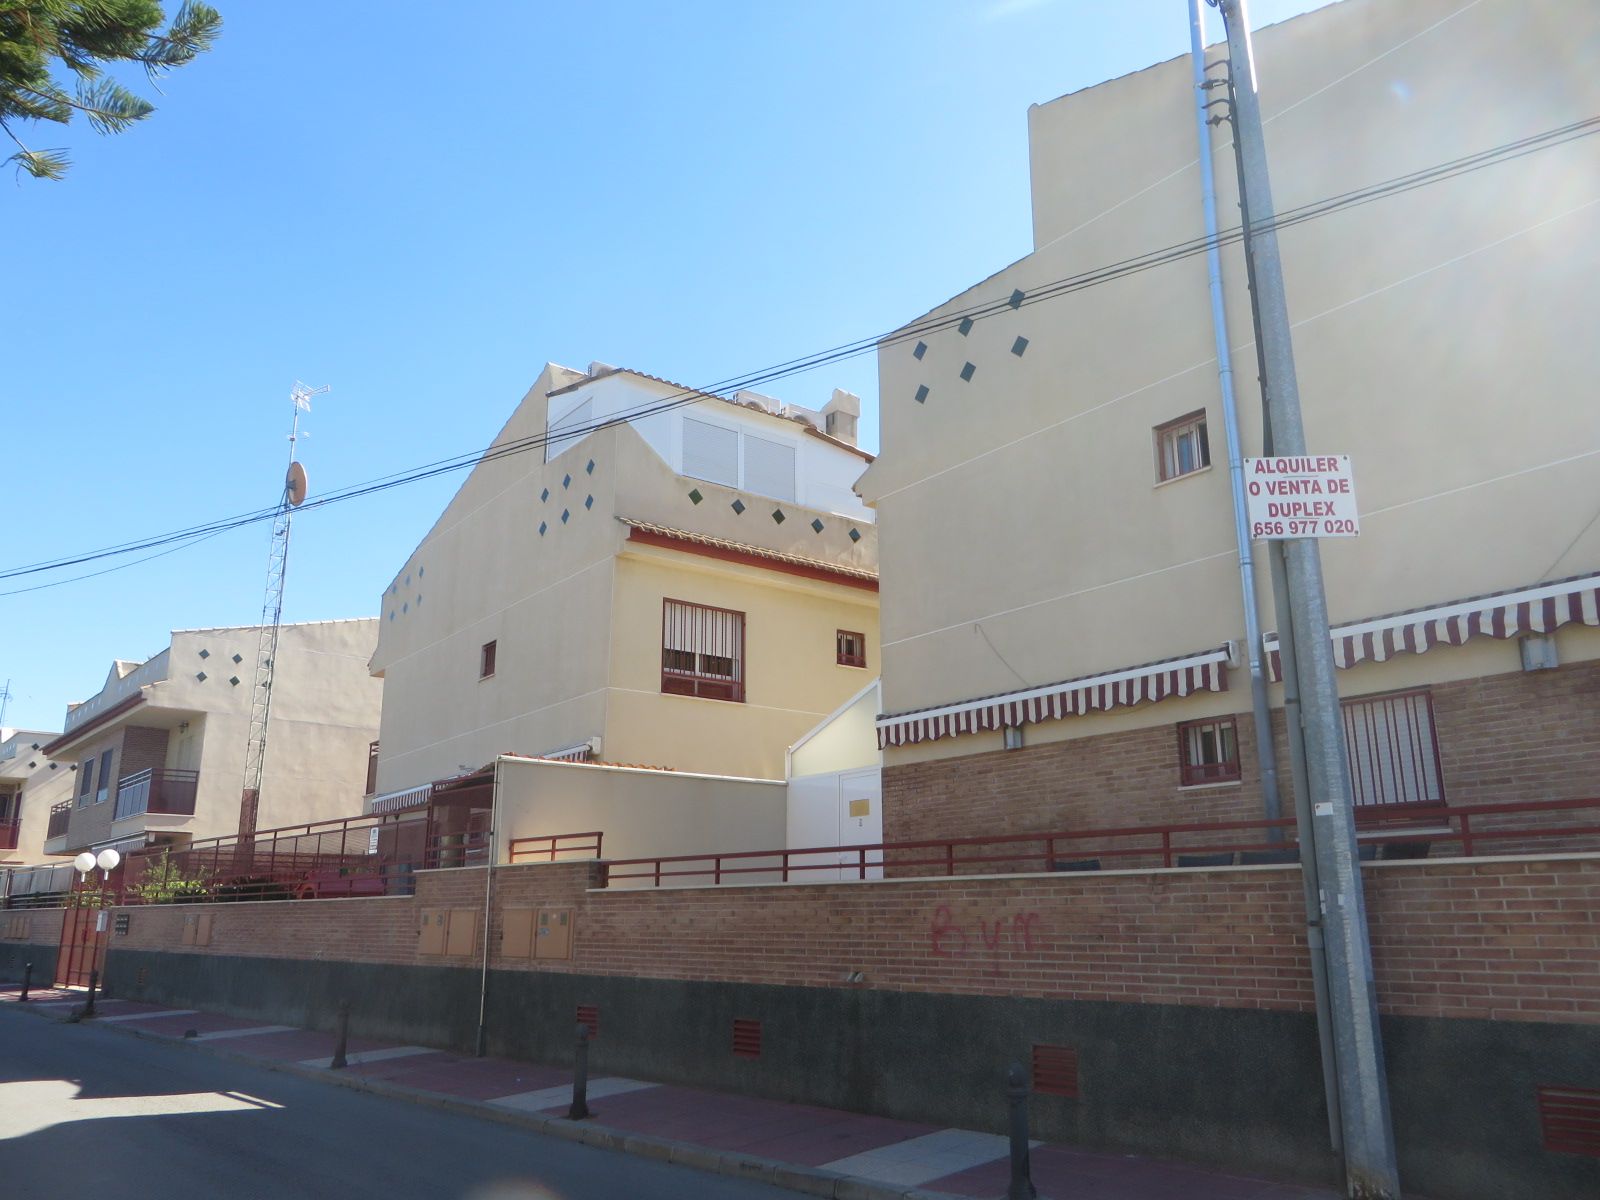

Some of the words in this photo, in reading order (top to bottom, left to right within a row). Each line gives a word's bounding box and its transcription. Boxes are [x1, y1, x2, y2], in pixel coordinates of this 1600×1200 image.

[1255, 457, 1339, 474] ALQUILER
[1248, 481, 1261, 496] O
[1265, 480, 1323, 495] VENTA
[1327, 479, 1350, 493] DE
[1268, 501, 1336, 517] DUPLEX
[1253, 522, 1284, 535] 656
[1289, 521, 1318, 534] 977
[1324, 519, 1354, 533] 020
